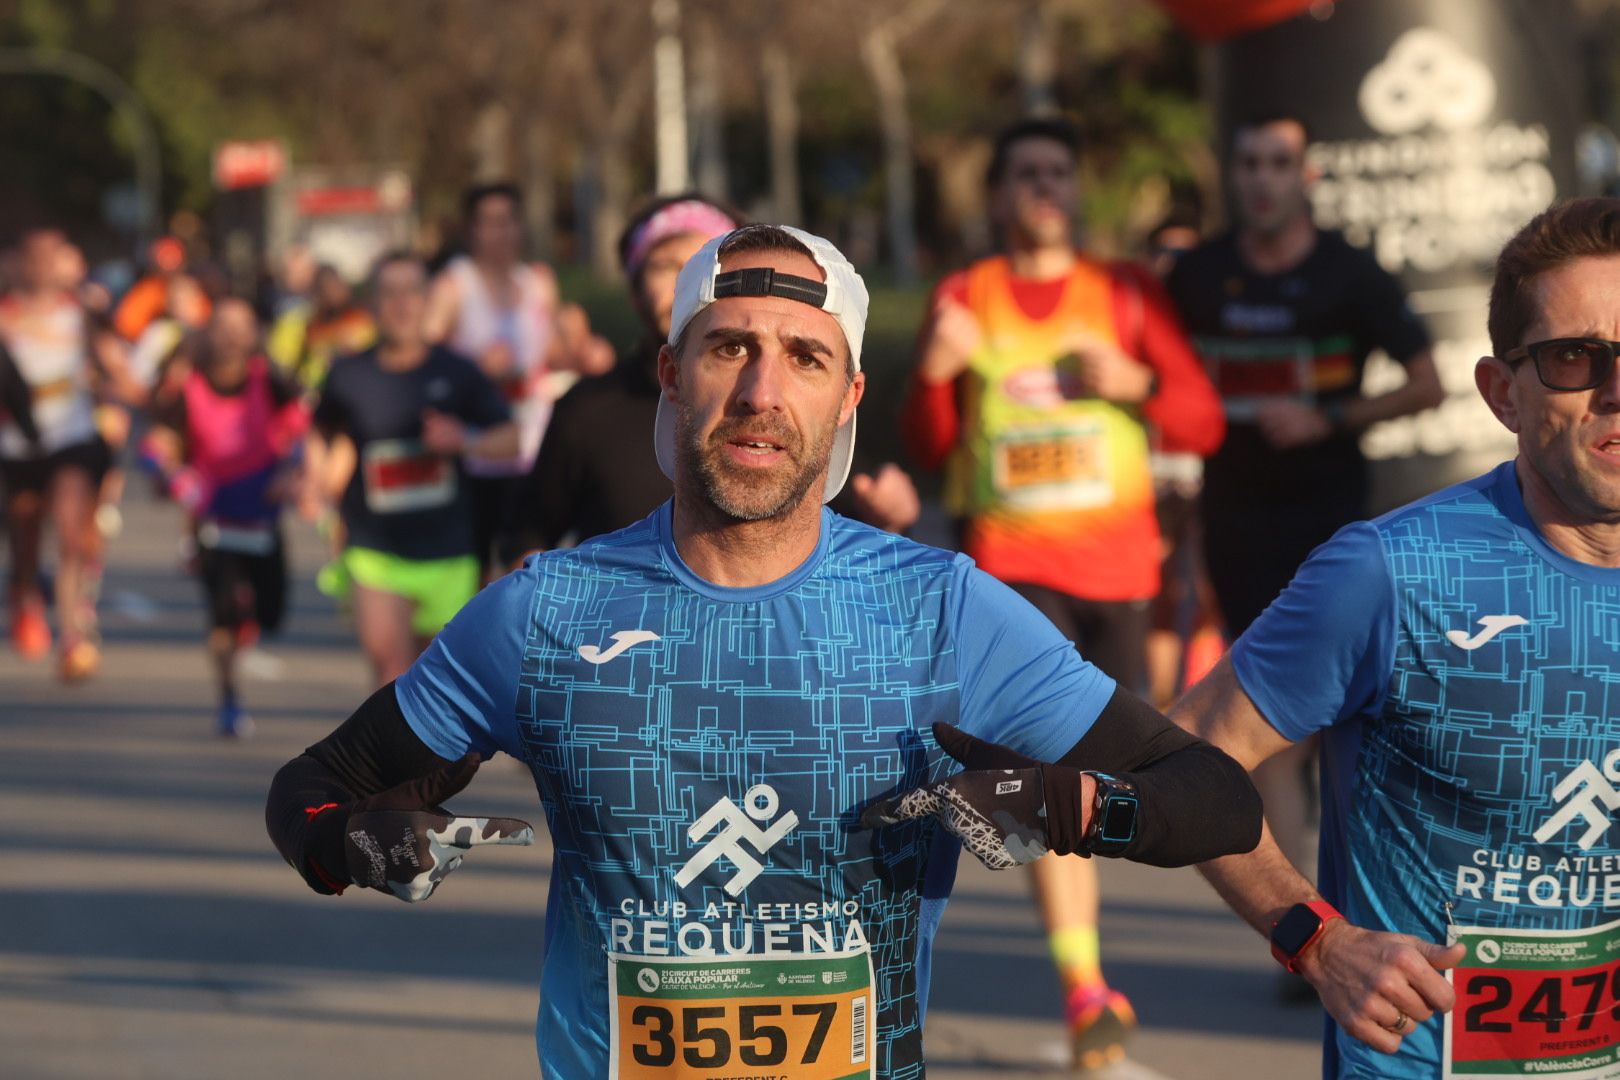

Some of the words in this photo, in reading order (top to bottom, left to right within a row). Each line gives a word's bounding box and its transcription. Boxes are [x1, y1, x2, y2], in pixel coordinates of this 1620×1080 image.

[1473, 849, 1542, 871] CLUB
[1555, 856, 1620, 873] ATLET
[1455, 865, 1620, 907] REQUE
[620, 898, 687, 919] CLUB
[704, 900, 859, 920] ATLETISMO
[611, 917, 871, 955] REQUENA
[1534, 947, 1576, 956] POPULAR
[661, 975, 692, 984] CAIXA
[693, 974, 738, 984] POPULAR
[710, 968, 751, 976] CARRERES
[1465, 966, 1620, 1033] 247
[632, 1002, 838, 1068] 3557
[1539, 1037, 1601, 1051] PREFERENT
